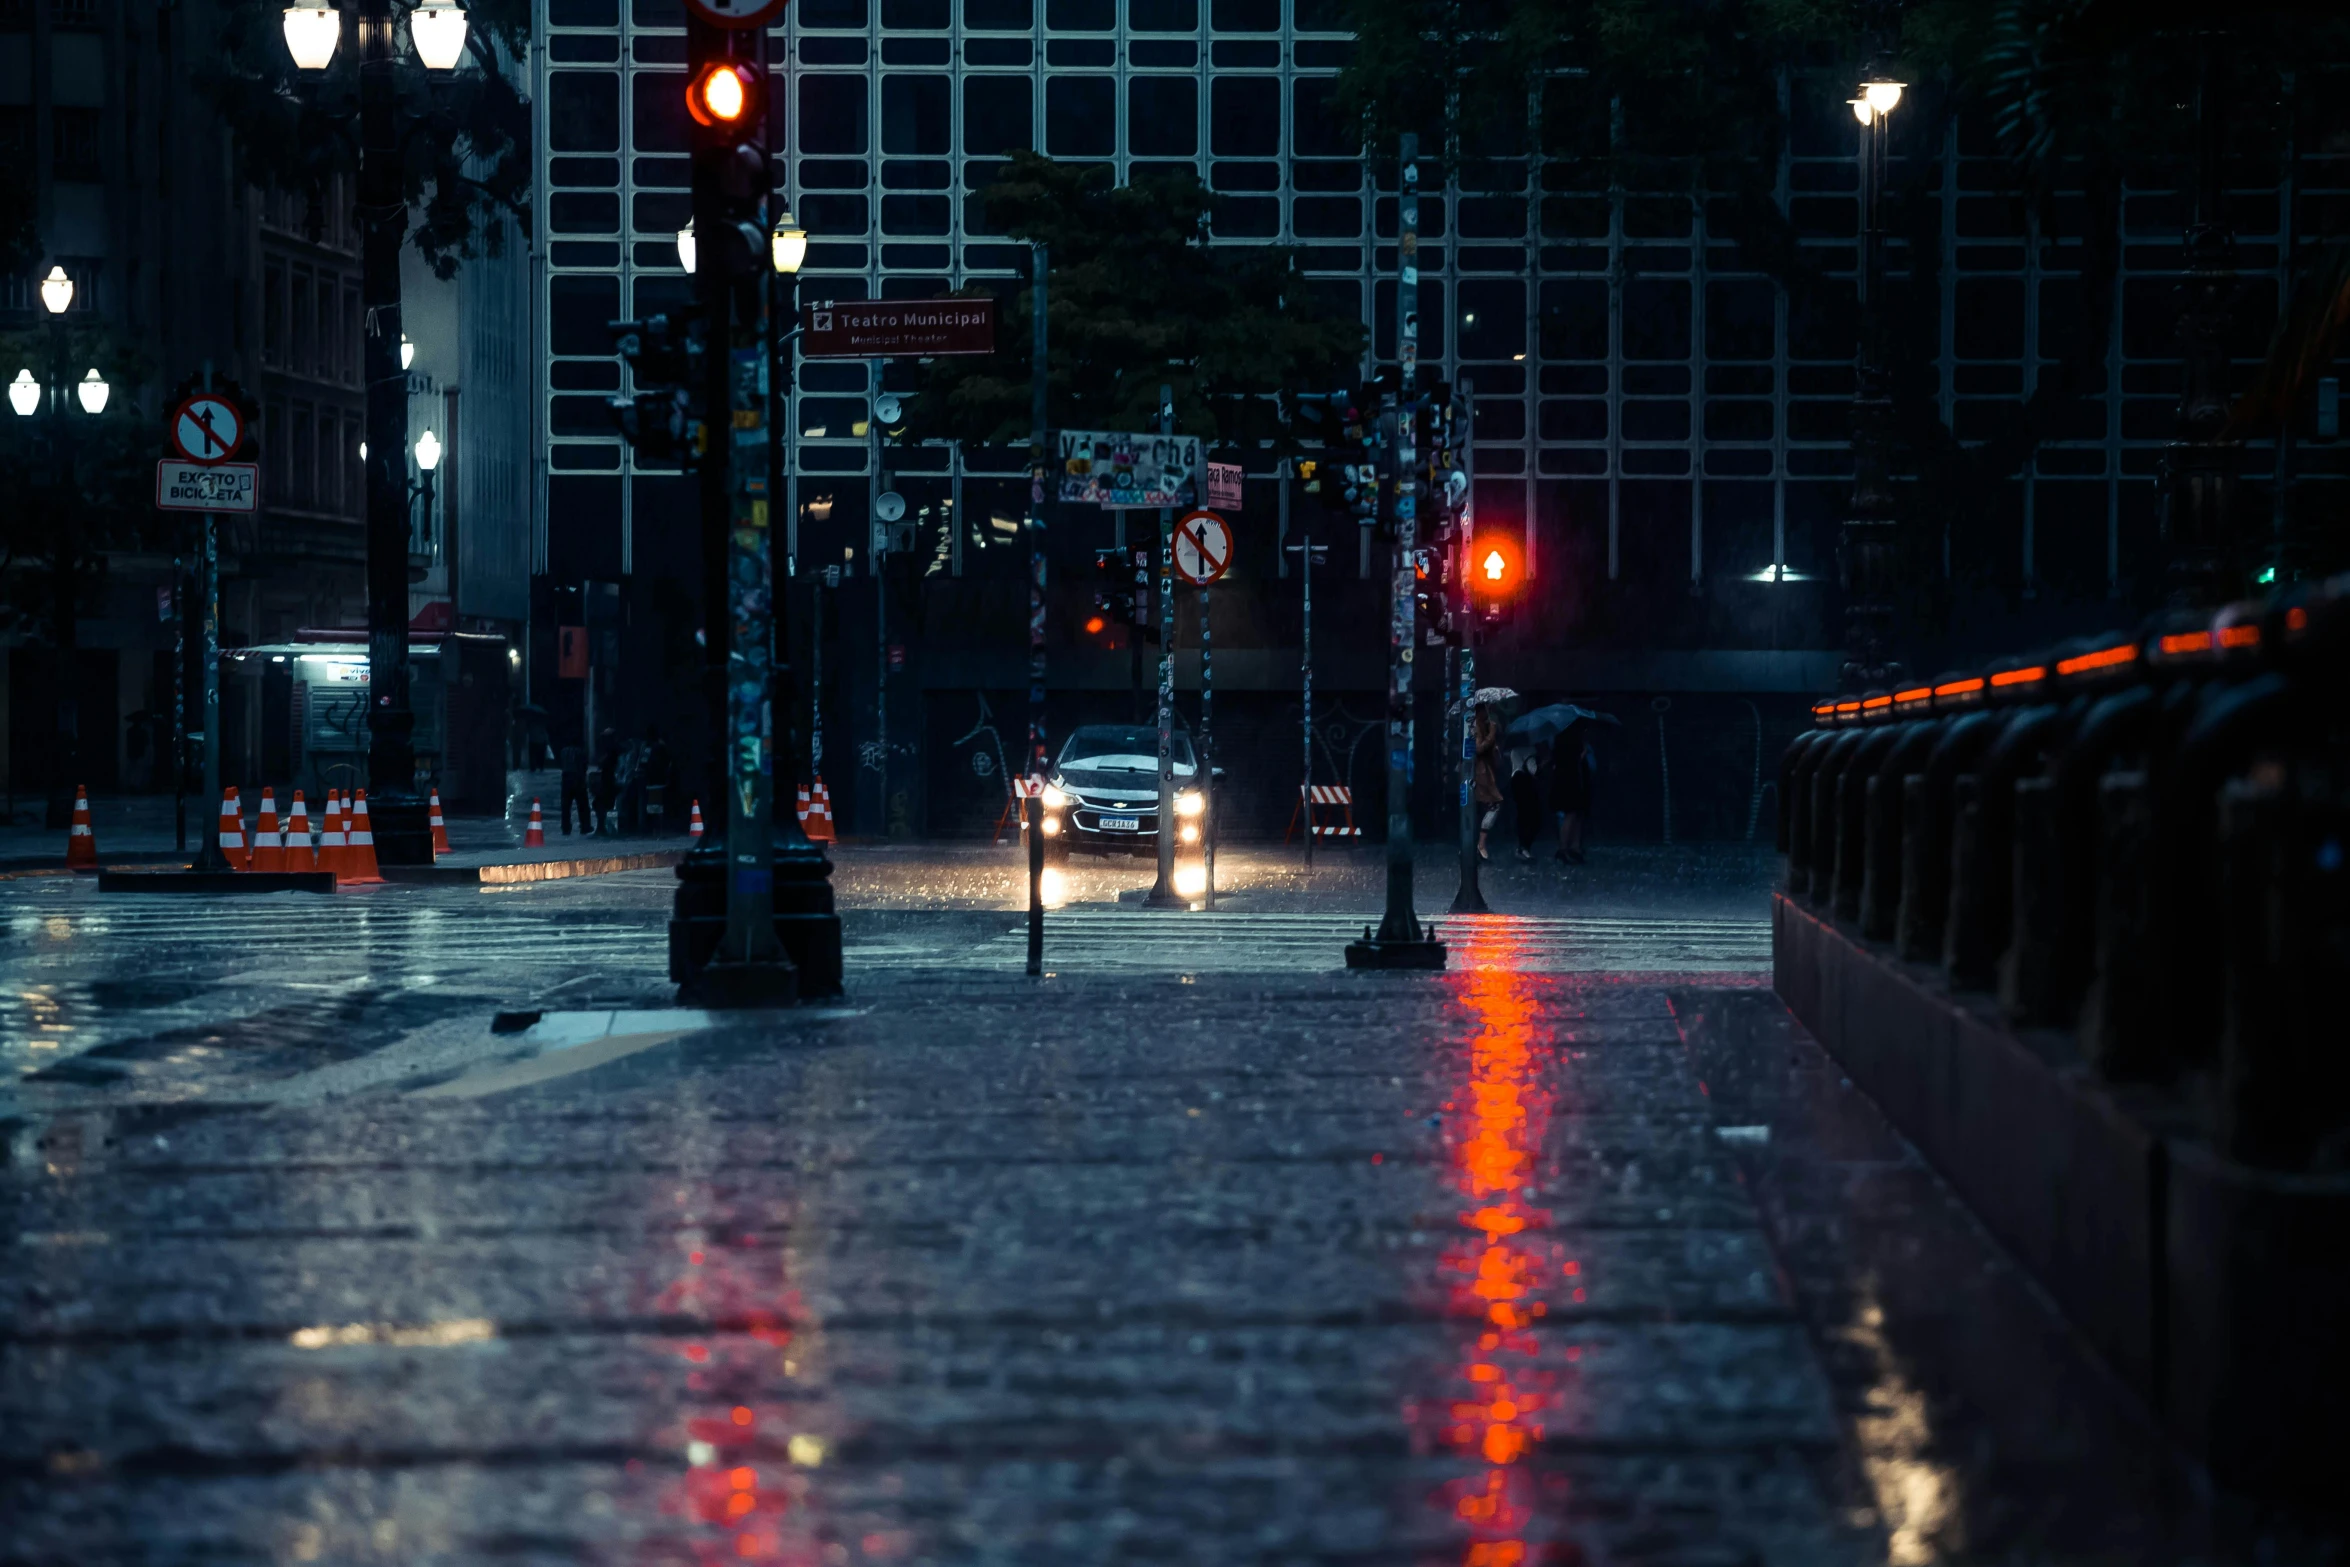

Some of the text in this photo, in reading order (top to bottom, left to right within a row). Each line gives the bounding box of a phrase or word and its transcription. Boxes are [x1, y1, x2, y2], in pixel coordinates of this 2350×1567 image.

[841, 311, 986, 328] Teatro Municipal
[851, 333, 948, 346] Municipal Theater
[1153, 438, 1196, 467] Chá
[1222, 466, 1242, 486] Ramos
